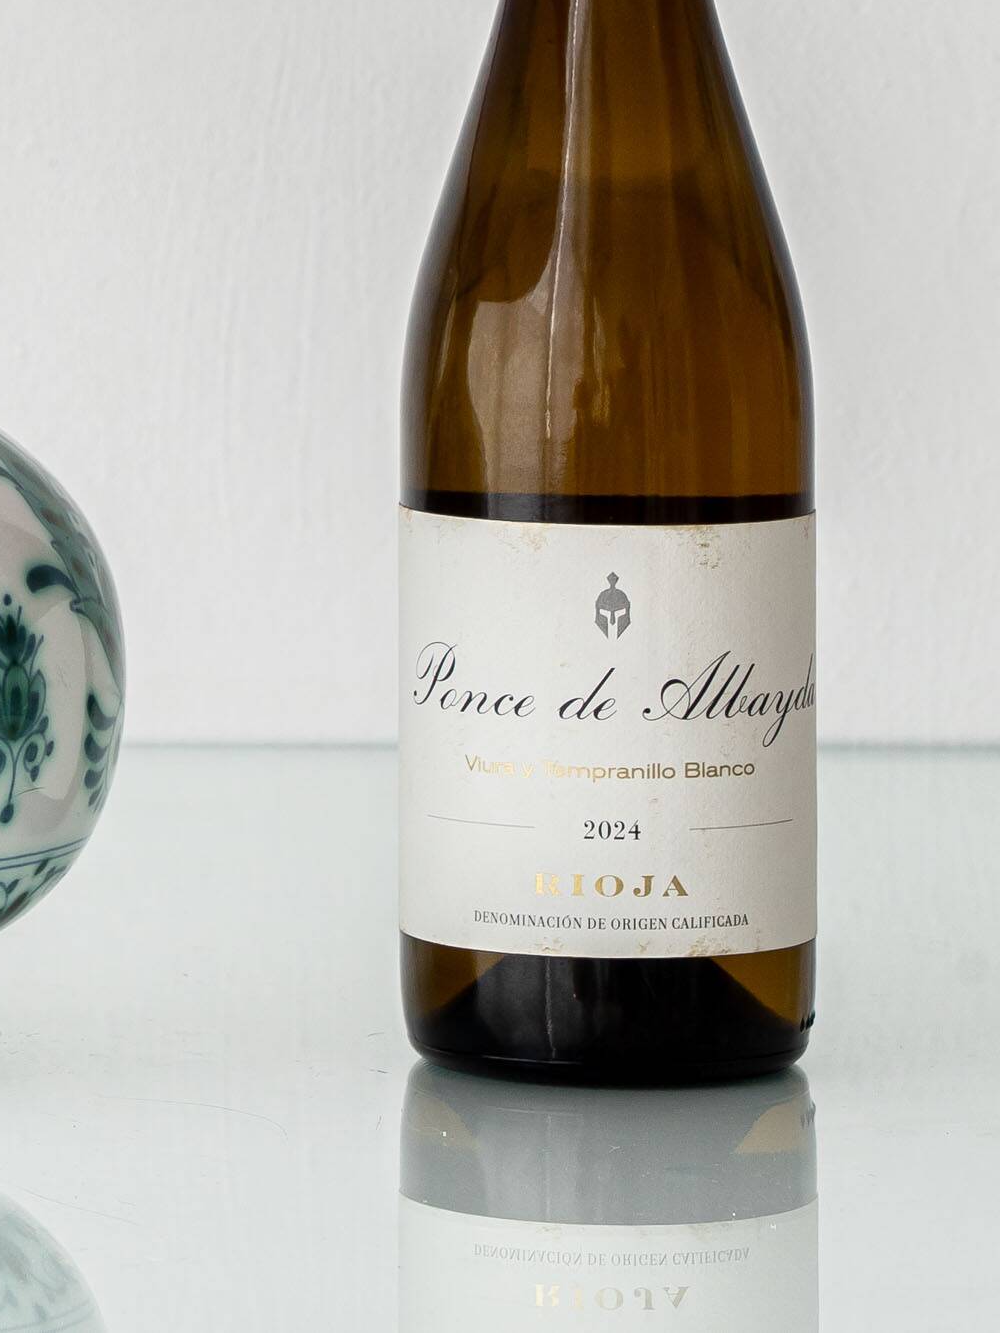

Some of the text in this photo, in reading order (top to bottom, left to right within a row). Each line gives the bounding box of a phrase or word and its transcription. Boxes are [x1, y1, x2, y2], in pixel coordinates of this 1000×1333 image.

[414, 642, 815, 747] Ponce de Albayda
[465, 754, 755, 782] Viura y Tempranillo Blanco
[583, 820, 641, 840] 2024
[535, 873, 689, 897] RIOJA
[474, 910, 749, 930] DENOMINACIÓN DE ORIGEN CALIFICADA
